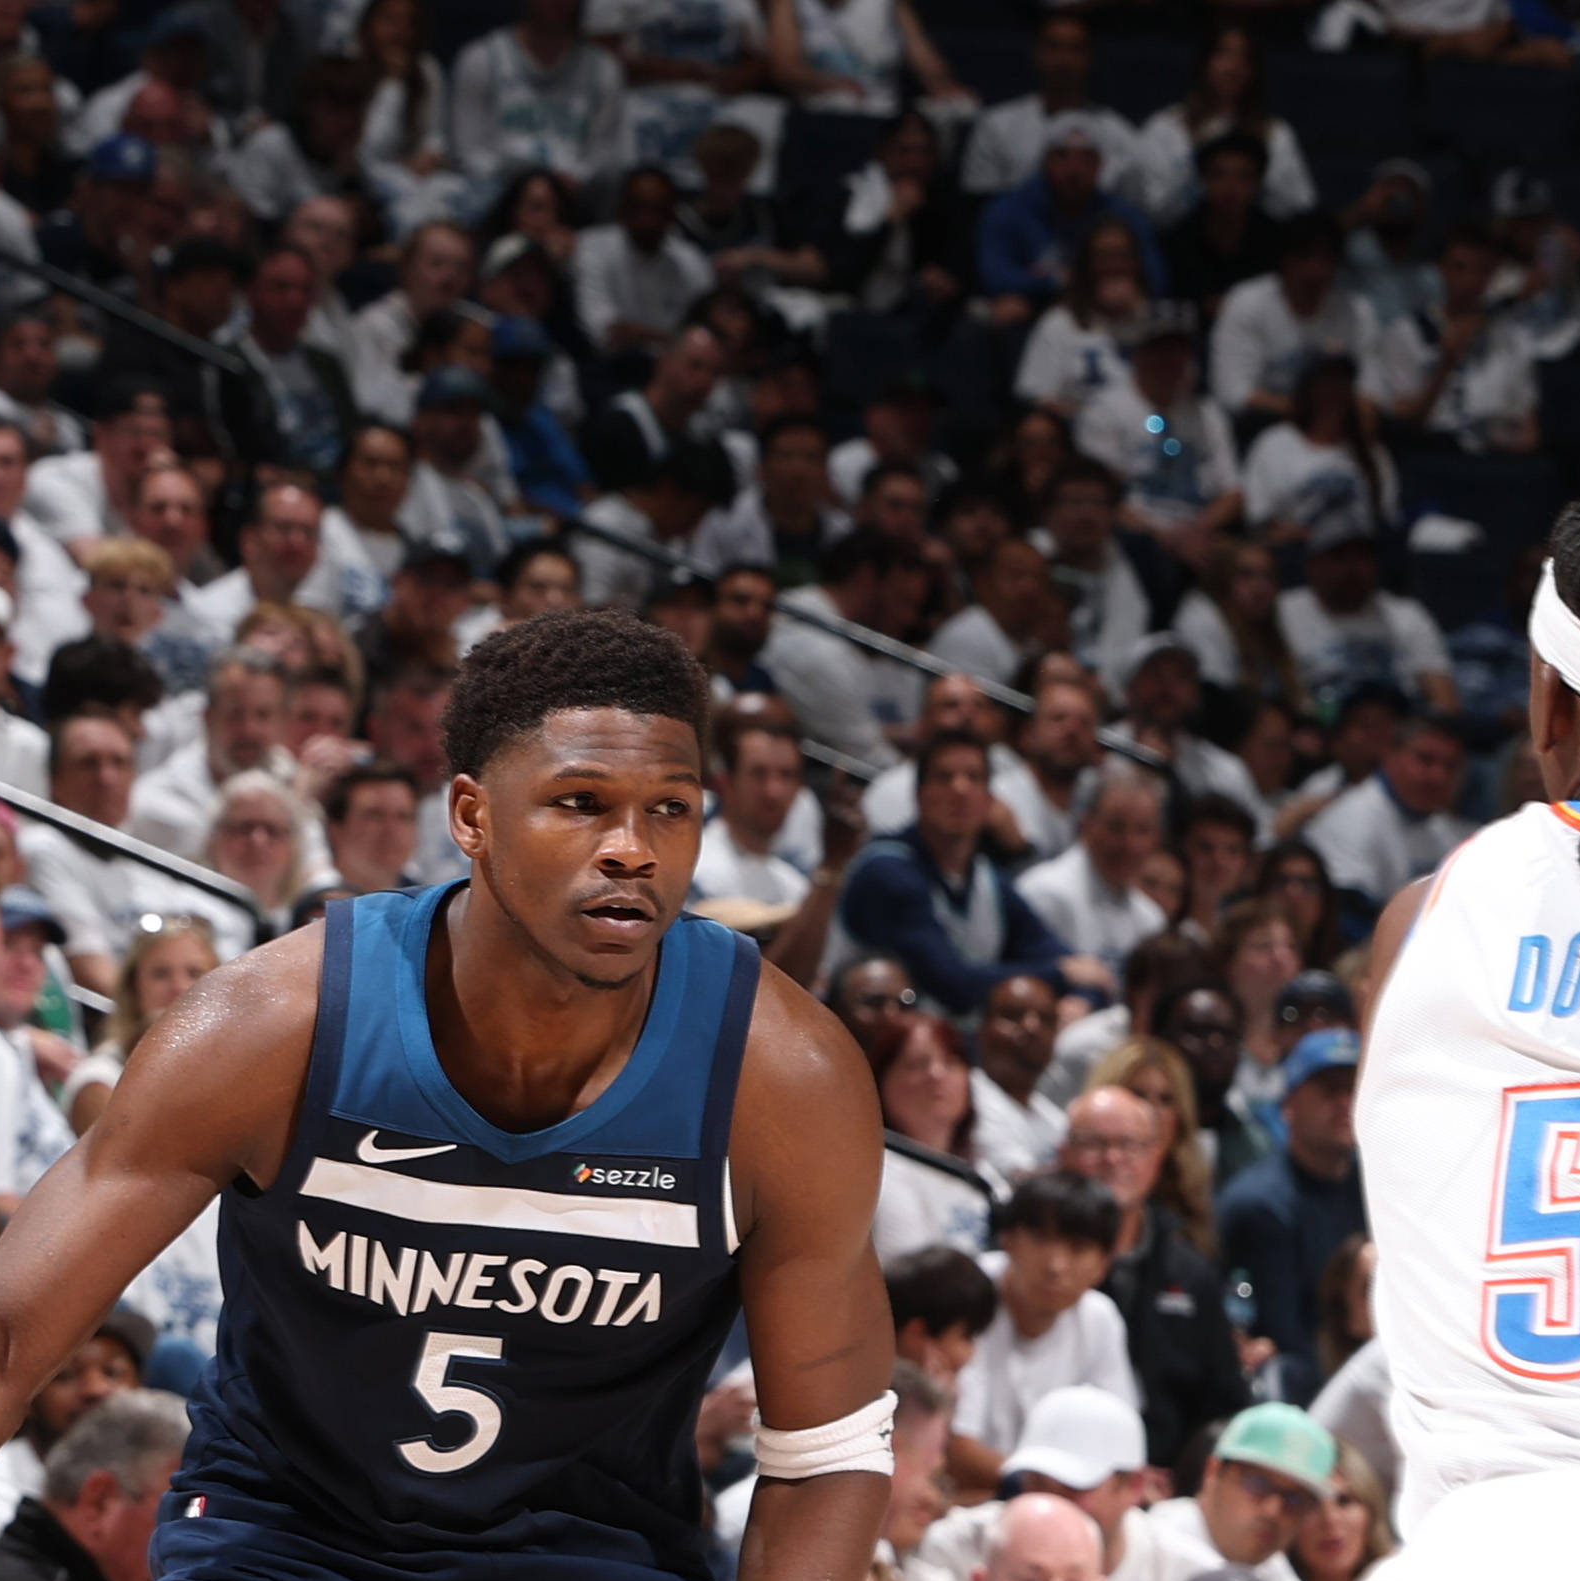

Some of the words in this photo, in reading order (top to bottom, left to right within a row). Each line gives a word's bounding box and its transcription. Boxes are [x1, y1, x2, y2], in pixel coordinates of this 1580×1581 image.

[590, 1166, 677, 1190] sezzle
[295, 1219, 662, 1327] MINNESOTA
[394, 1330, 507, 1477] 5
